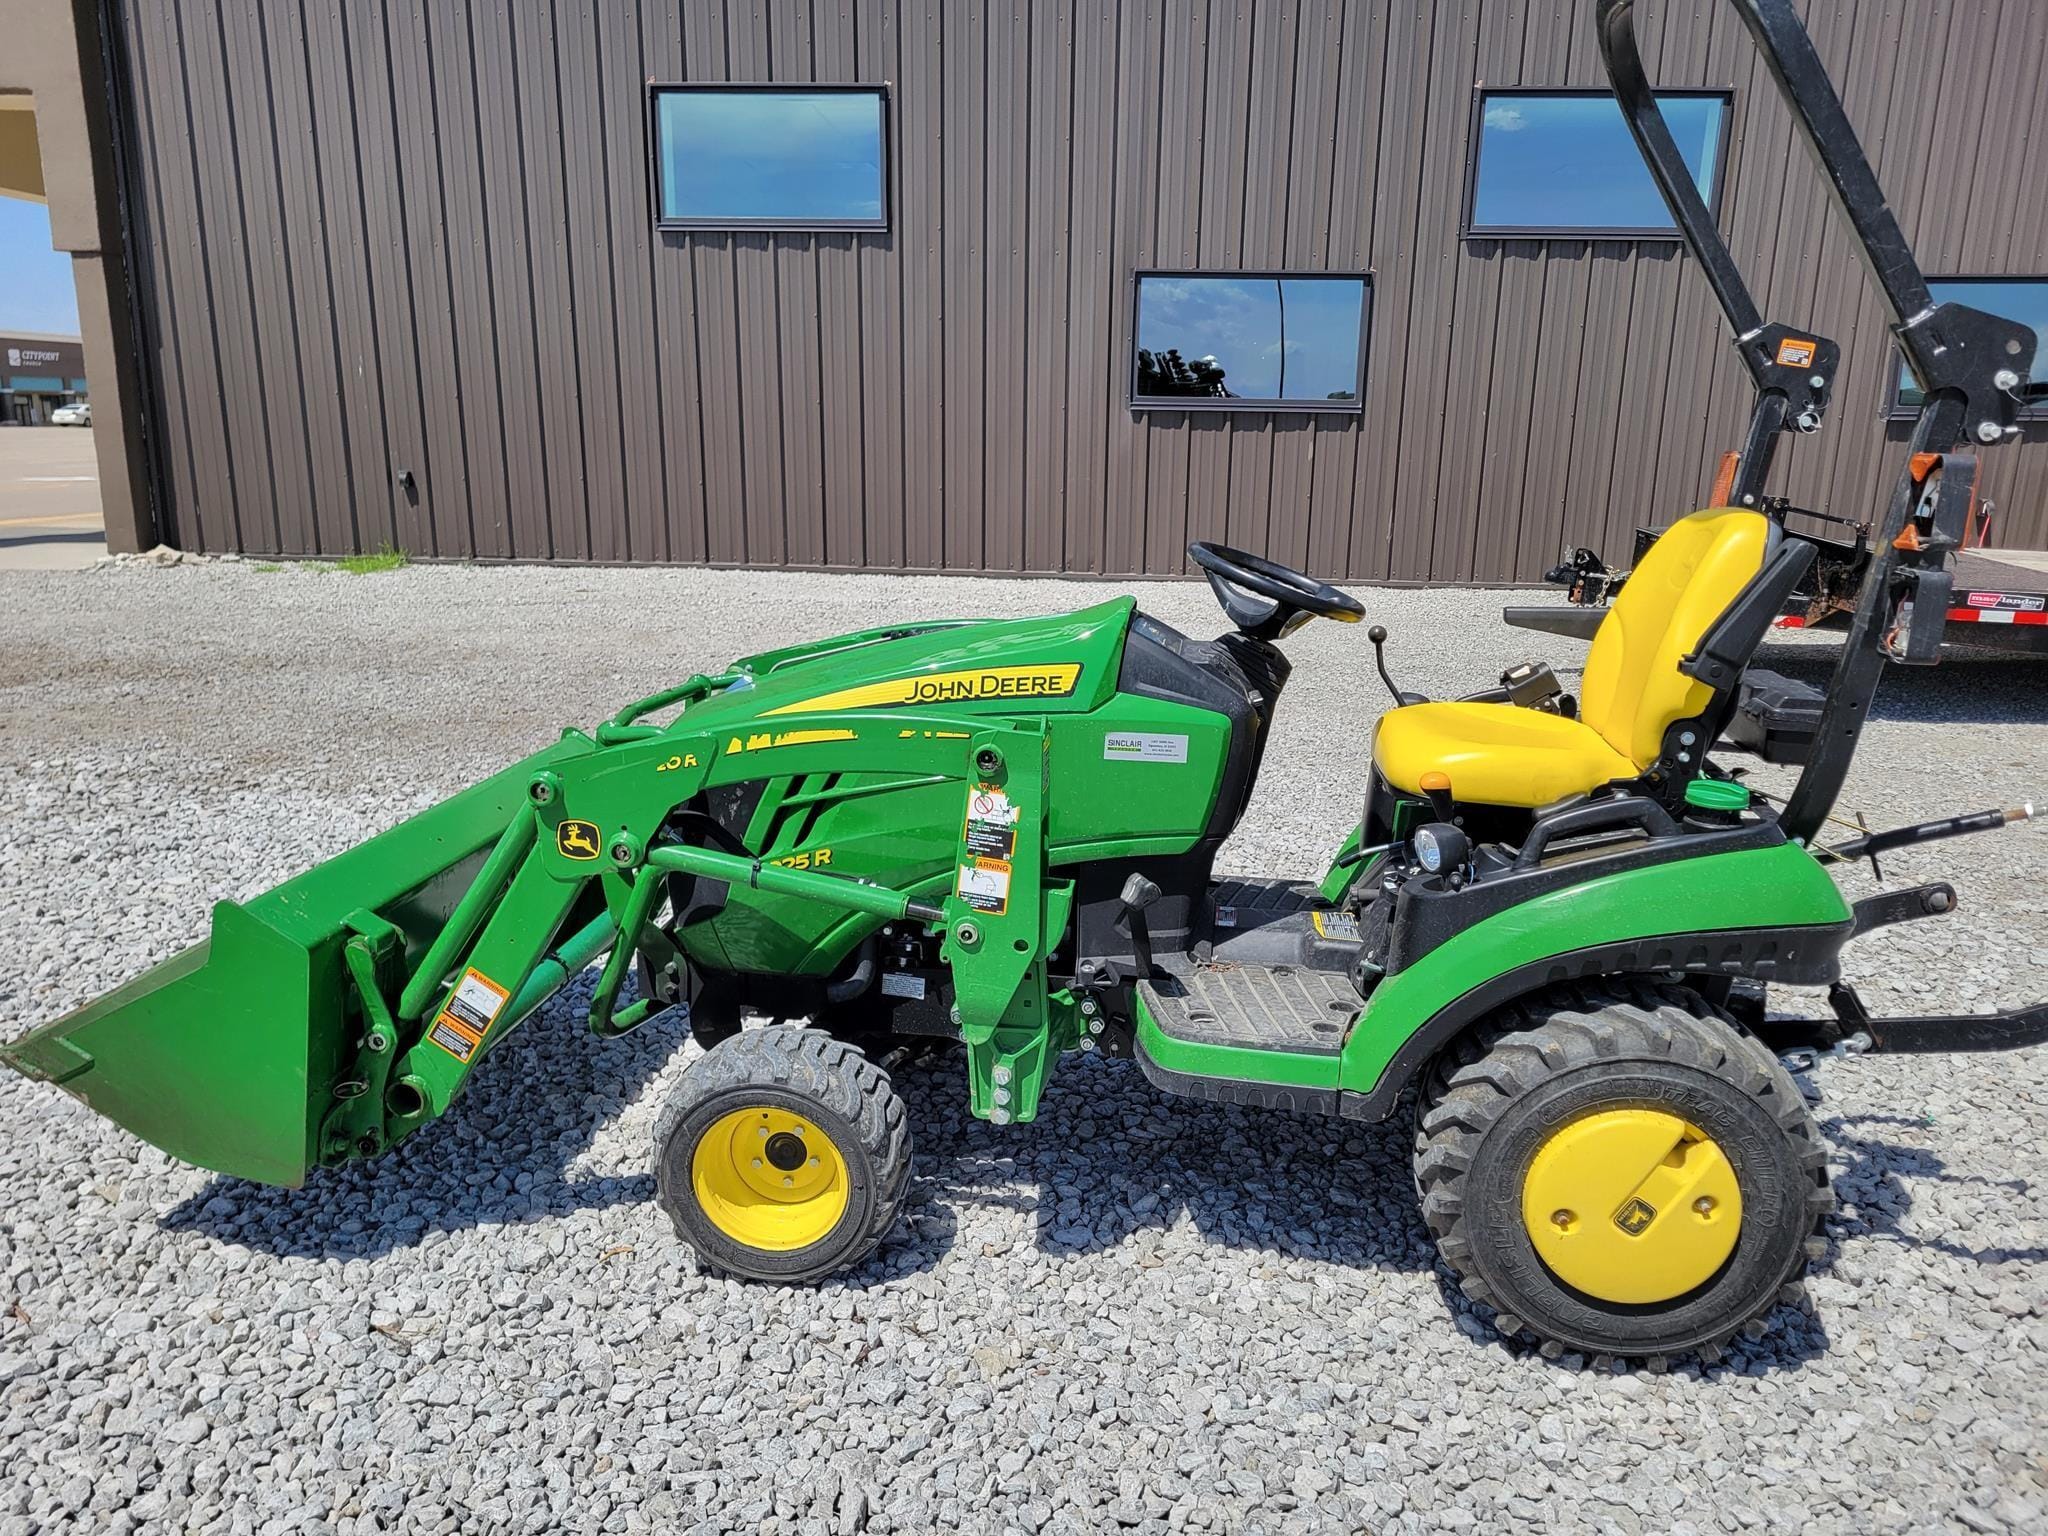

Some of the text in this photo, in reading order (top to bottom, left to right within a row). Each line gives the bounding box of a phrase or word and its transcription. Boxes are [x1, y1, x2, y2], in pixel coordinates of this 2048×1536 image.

[2002, 596, 2043, 606] lander
[904, 675, 1063, 701] JOHN DEERE
[1107, 739, 1142, 748] SINCLAIR
